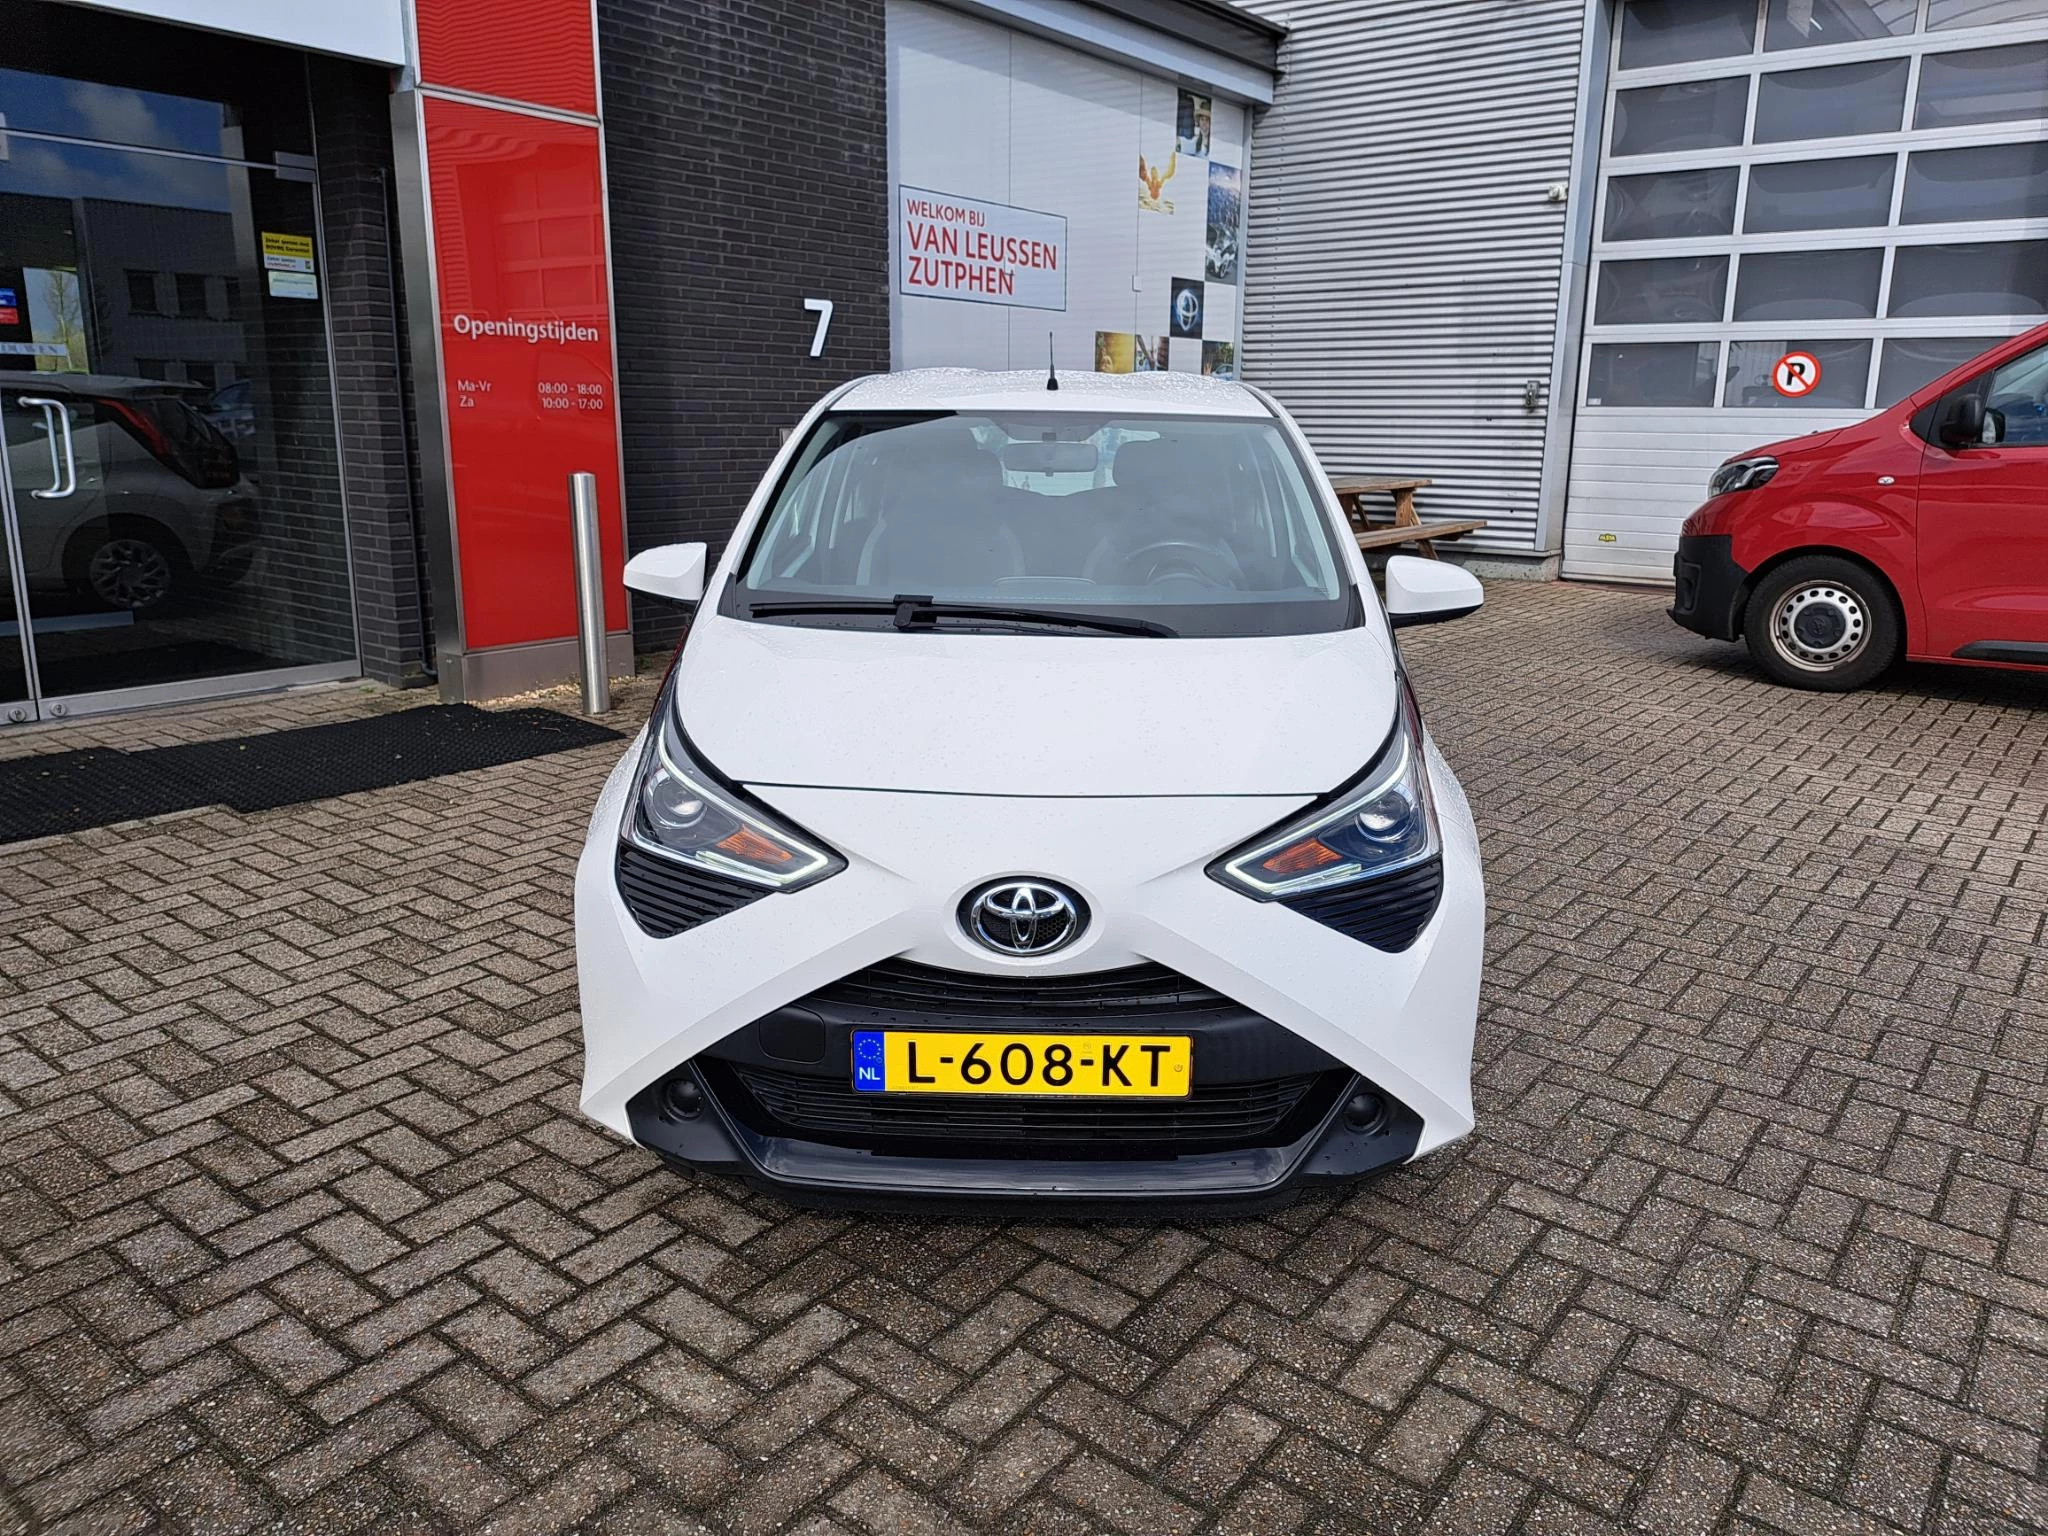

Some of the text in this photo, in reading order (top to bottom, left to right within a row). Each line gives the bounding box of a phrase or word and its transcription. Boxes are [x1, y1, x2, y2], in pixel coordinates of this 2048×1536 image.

[907, 199, 985, 228] WELKOM BIJ
[907, 221, 1057, 270] VAN LEUSSEN
[908, 255, 1015, 296] ZUTPHEN
[453, 314, 599, 345] Openingstijden
[804, 298, 833, 357] 7
[457, 379, 491, 392] Ma-Vr
[538, 382, 568, 394] 08:00
[577, 383, 603, 395] 18:00
[459, 394, 475, 408] Za
[542, 397, 569, 409] 10:00
[578, 398, 604, 410] 17:00
[858, 1066, 881, 1081] NL
[908, 1041, 1171, 1088] L-608-KT
